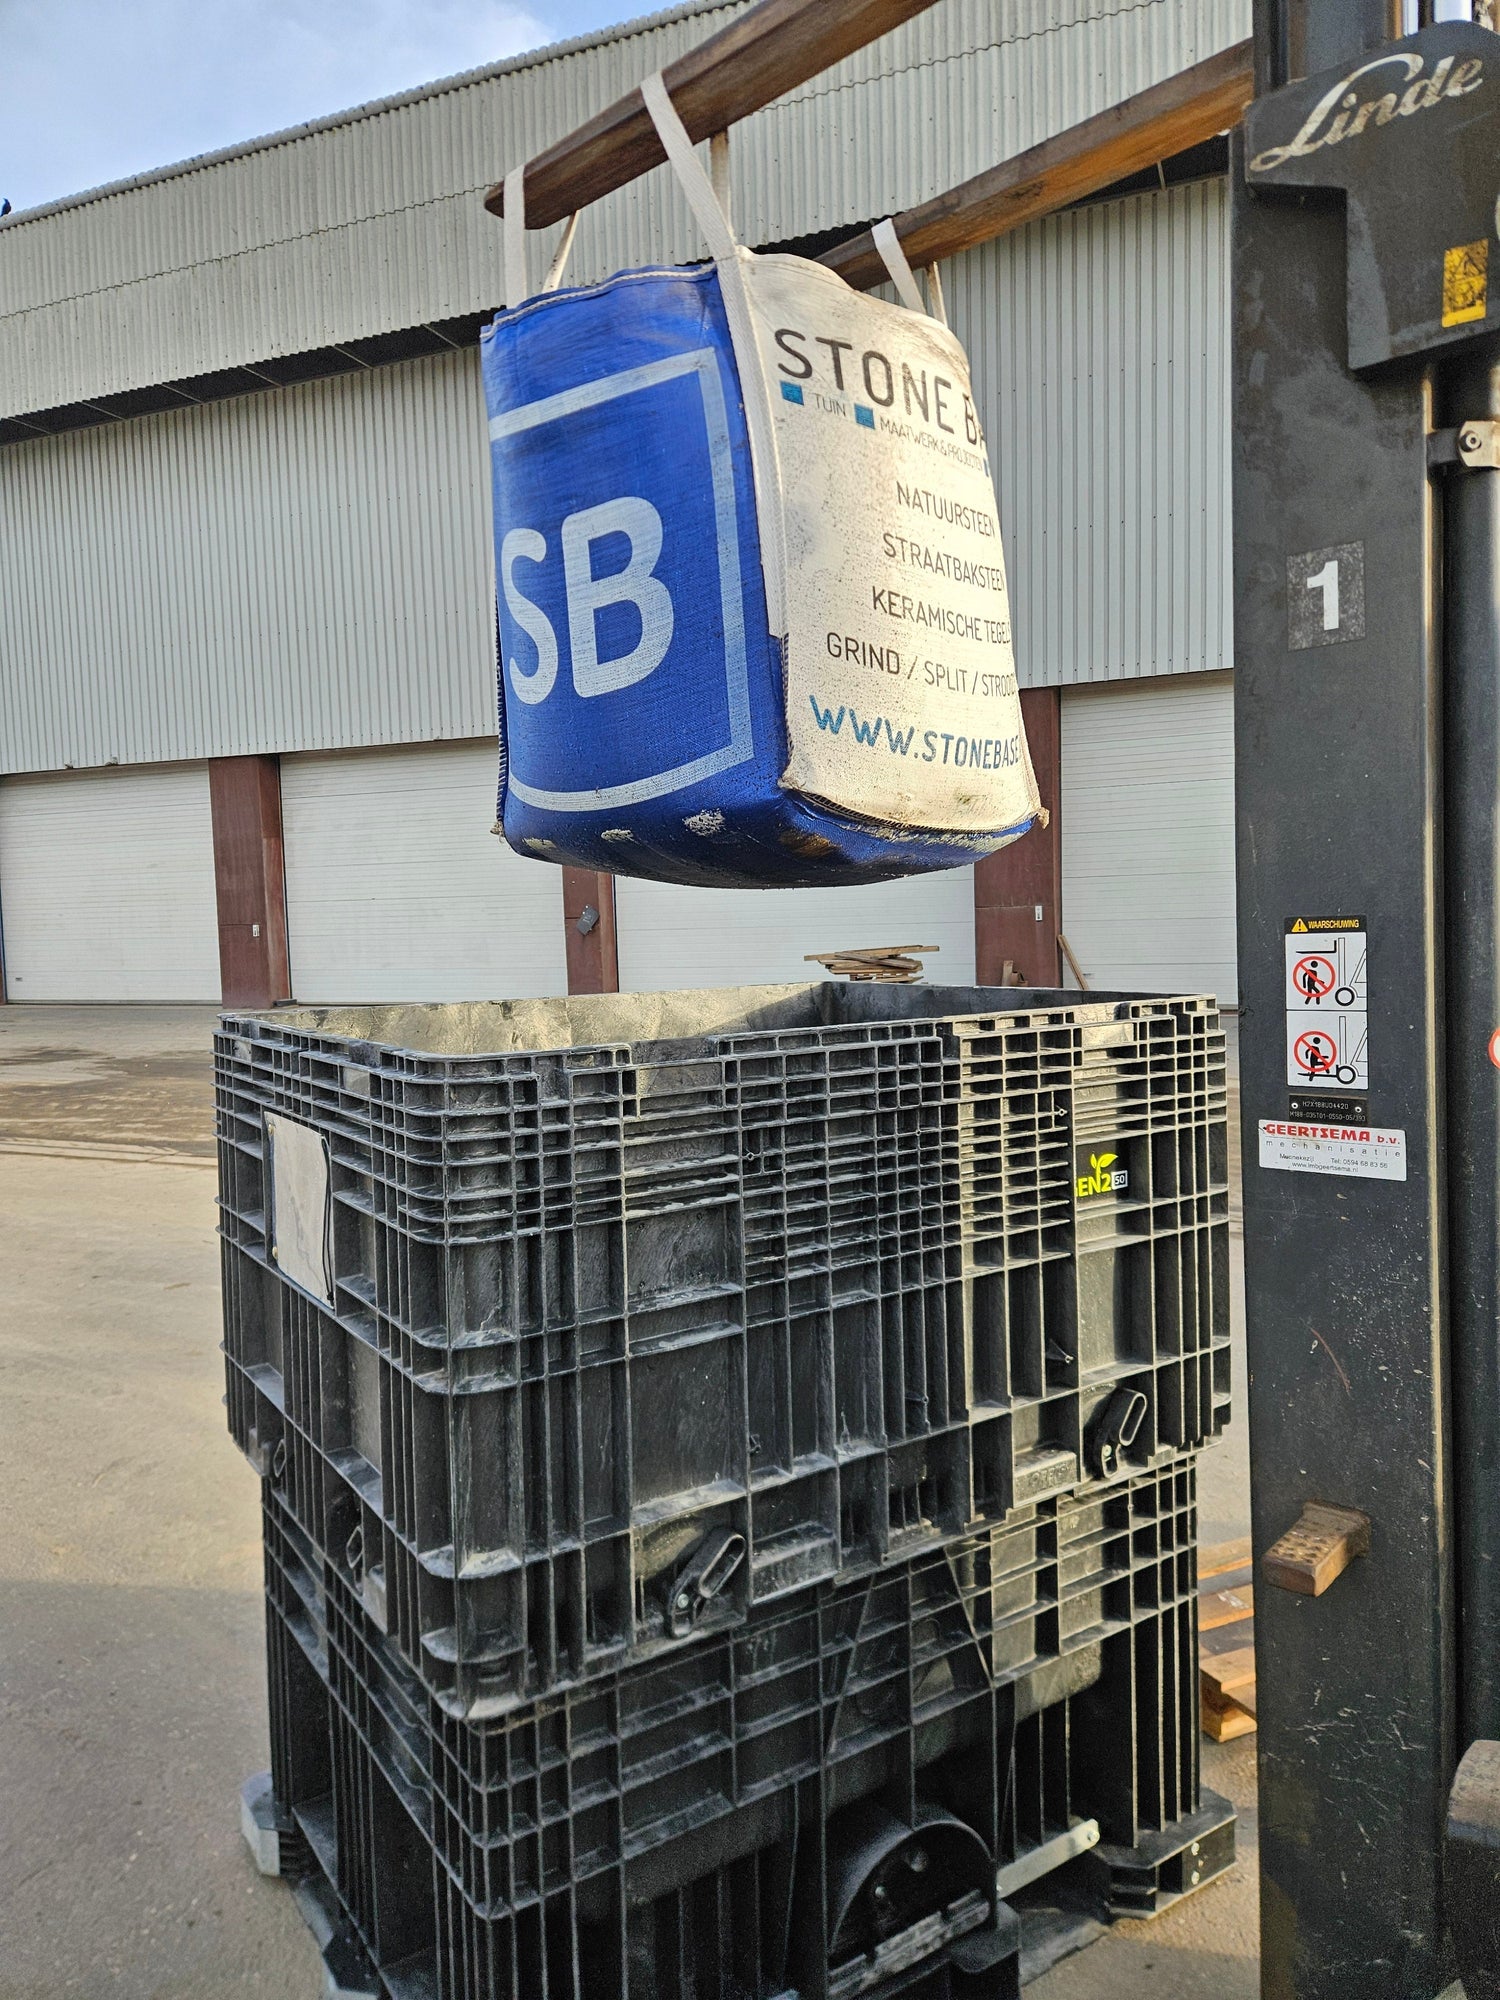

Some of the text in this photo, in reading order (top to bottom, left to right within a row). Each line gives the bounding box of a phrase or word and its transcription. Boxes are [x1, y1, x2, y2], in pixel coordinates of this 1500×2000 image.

[1250, 53, 1483, 172] Linde
[775, 328, 954, 434] STONE
[813, 392, 847, 418] TUIN
[880, 416, 940, 451] MAATWERK
[896, 480, 996, 538] NATUURSTEEN
[883, 532, 1005, 592] STRAATBAKSTEEN
[501, 496, 674, 705] SB
[872, 585, 982, 642] KERAMISCHE
[1306, 560, 1339, 631] 1
[827, 632, 900, 675] GRIND
[907, 655, 918, 680] /
[924, 660, 968, 693] SPLIT
[972, 670, 978, 696] /
[1308, 919, 1360, 929] WAARSCHUWING
[1265, 1124, 1401, 1145] GEERTSEMA b.v.
[1265, 1140, 1401, 1158] mechanisatie
